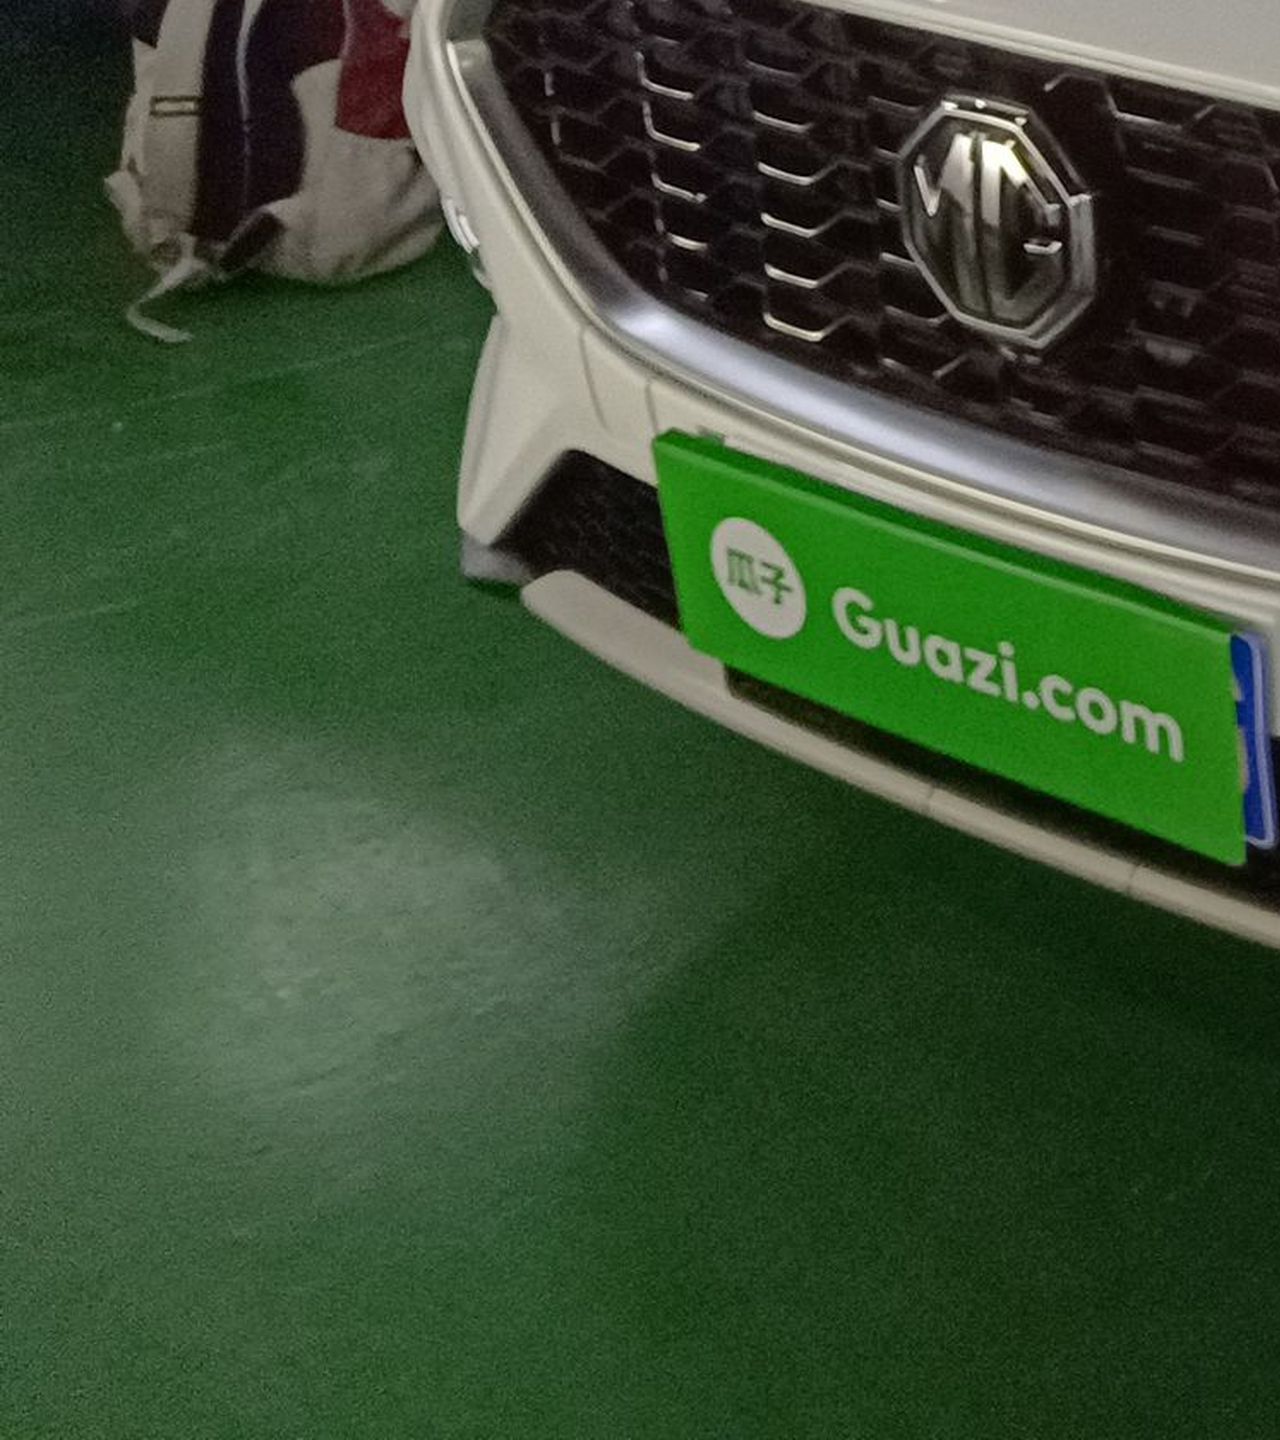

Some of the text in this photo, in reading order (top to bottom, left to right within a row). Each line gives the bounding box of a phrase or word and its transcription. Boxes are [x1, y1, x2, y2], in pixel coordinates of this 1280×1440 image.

[912, 131, 1064, 322] MG
[726, 547, 793, 606] 瓜子
[831, 586, 1184, 763] Guazi.com
